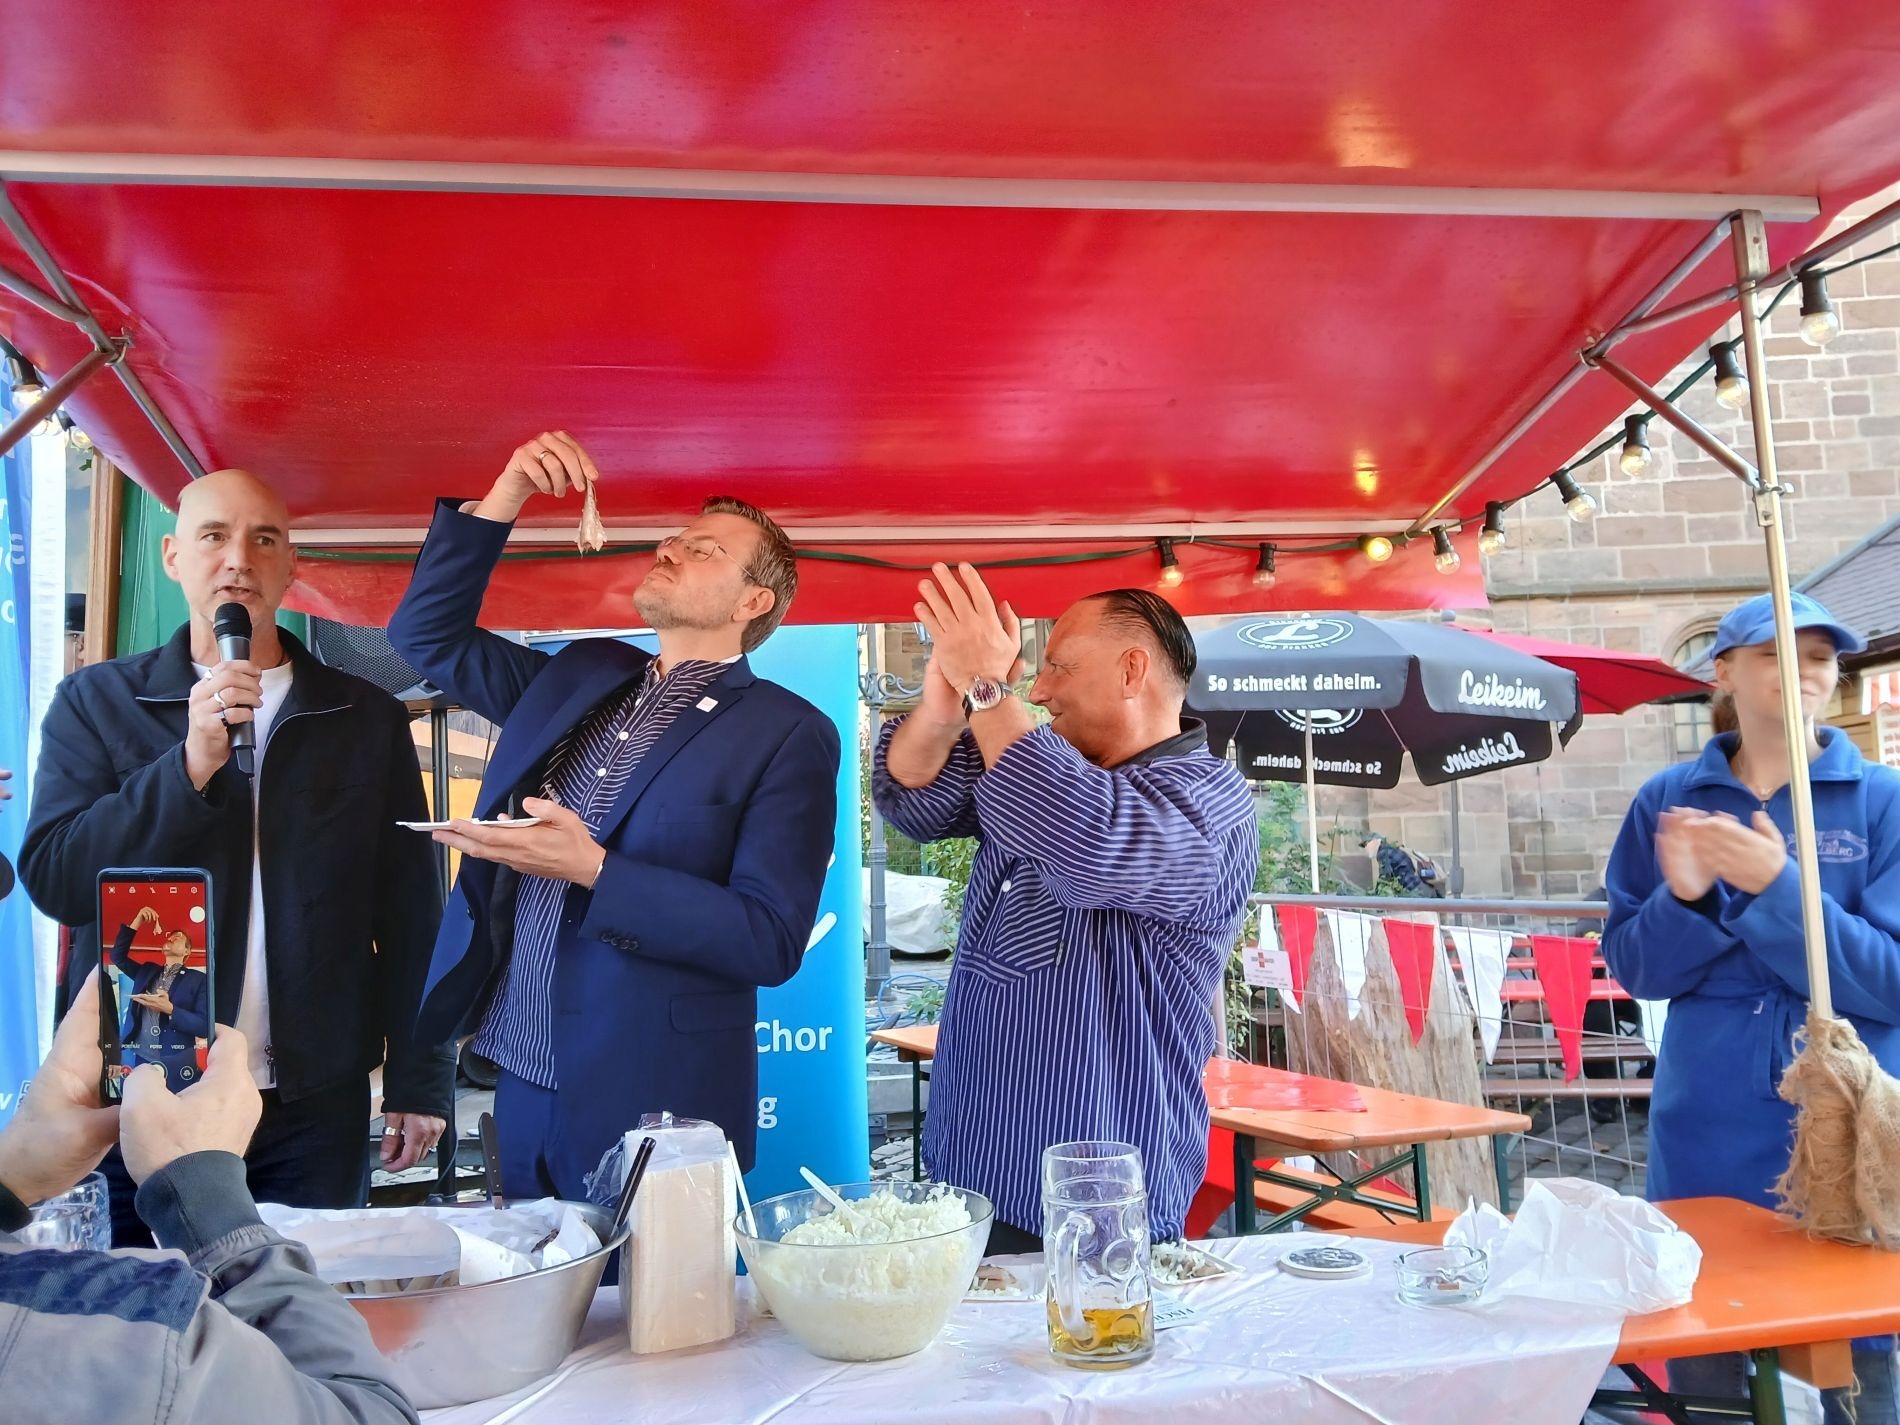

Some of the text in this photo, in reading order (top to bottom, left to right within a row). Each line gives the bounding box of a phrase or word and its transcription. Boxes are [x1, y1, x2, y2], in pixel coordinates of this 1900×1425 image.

[1208, 673, 1382, 692] So schmeckt daheim.
[1458, 669, 1547, 711] Leikeim
[754, 1019, 833, 1053] Chor
